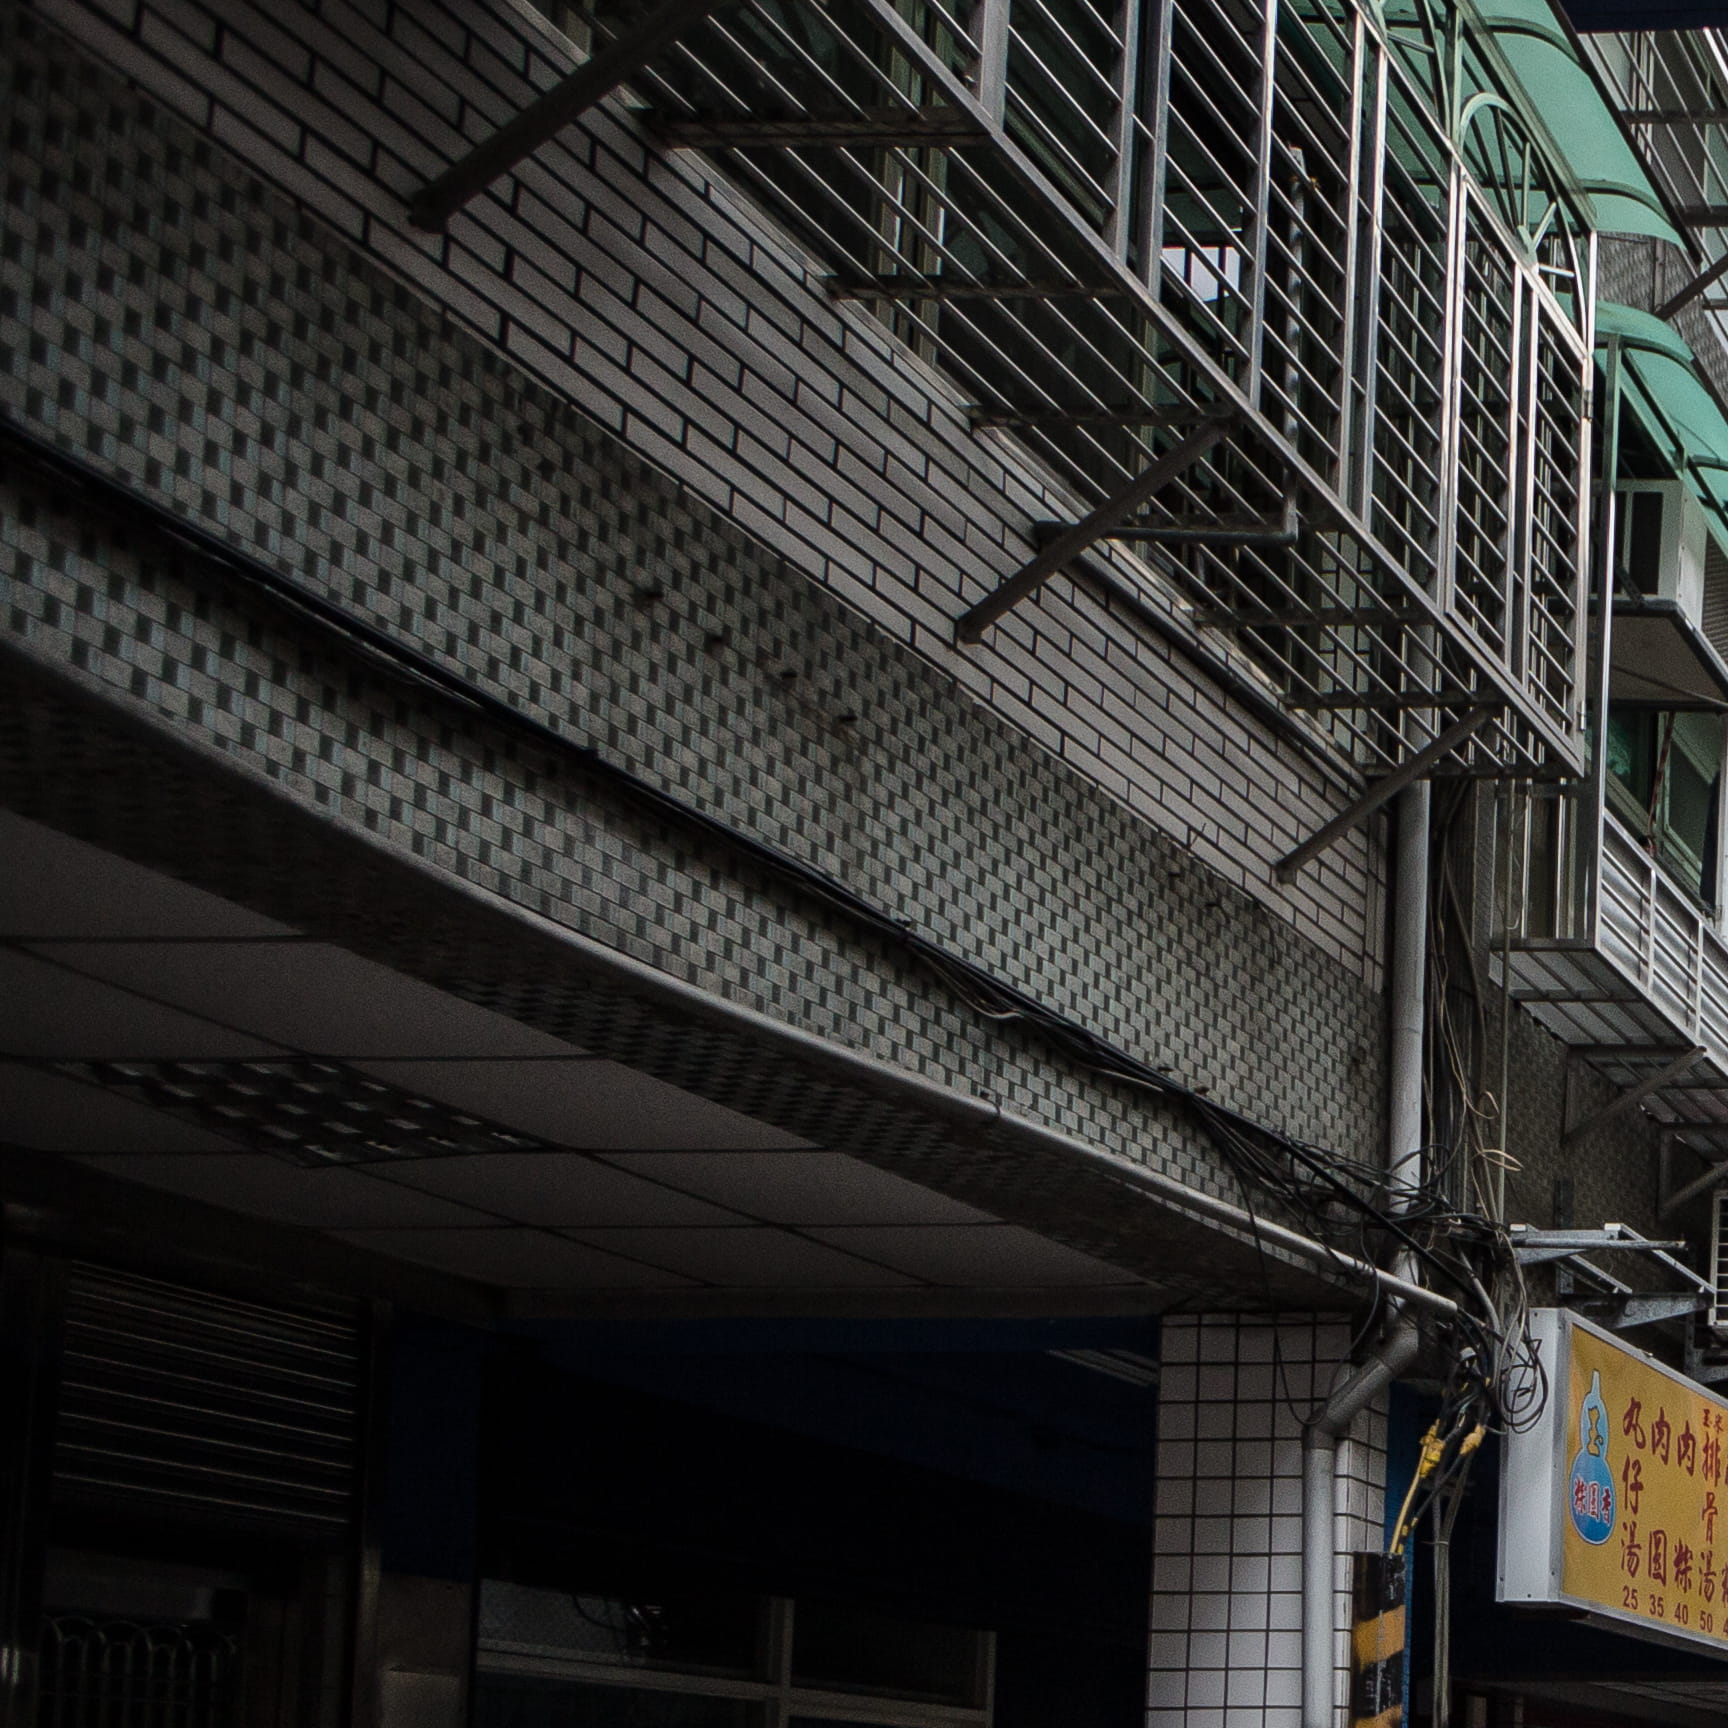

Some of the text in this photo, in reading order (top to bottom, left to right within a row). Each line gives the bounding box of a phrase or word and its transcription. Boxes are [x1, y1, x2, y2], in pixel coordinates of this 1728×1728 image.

[1622, 1584, 1639, 1610] 25
[1649, 1593, 1665, 1618] 35
[1674, 1602, 1689, 1625] 40
[1699, 1610, 1713, 1633] 50
